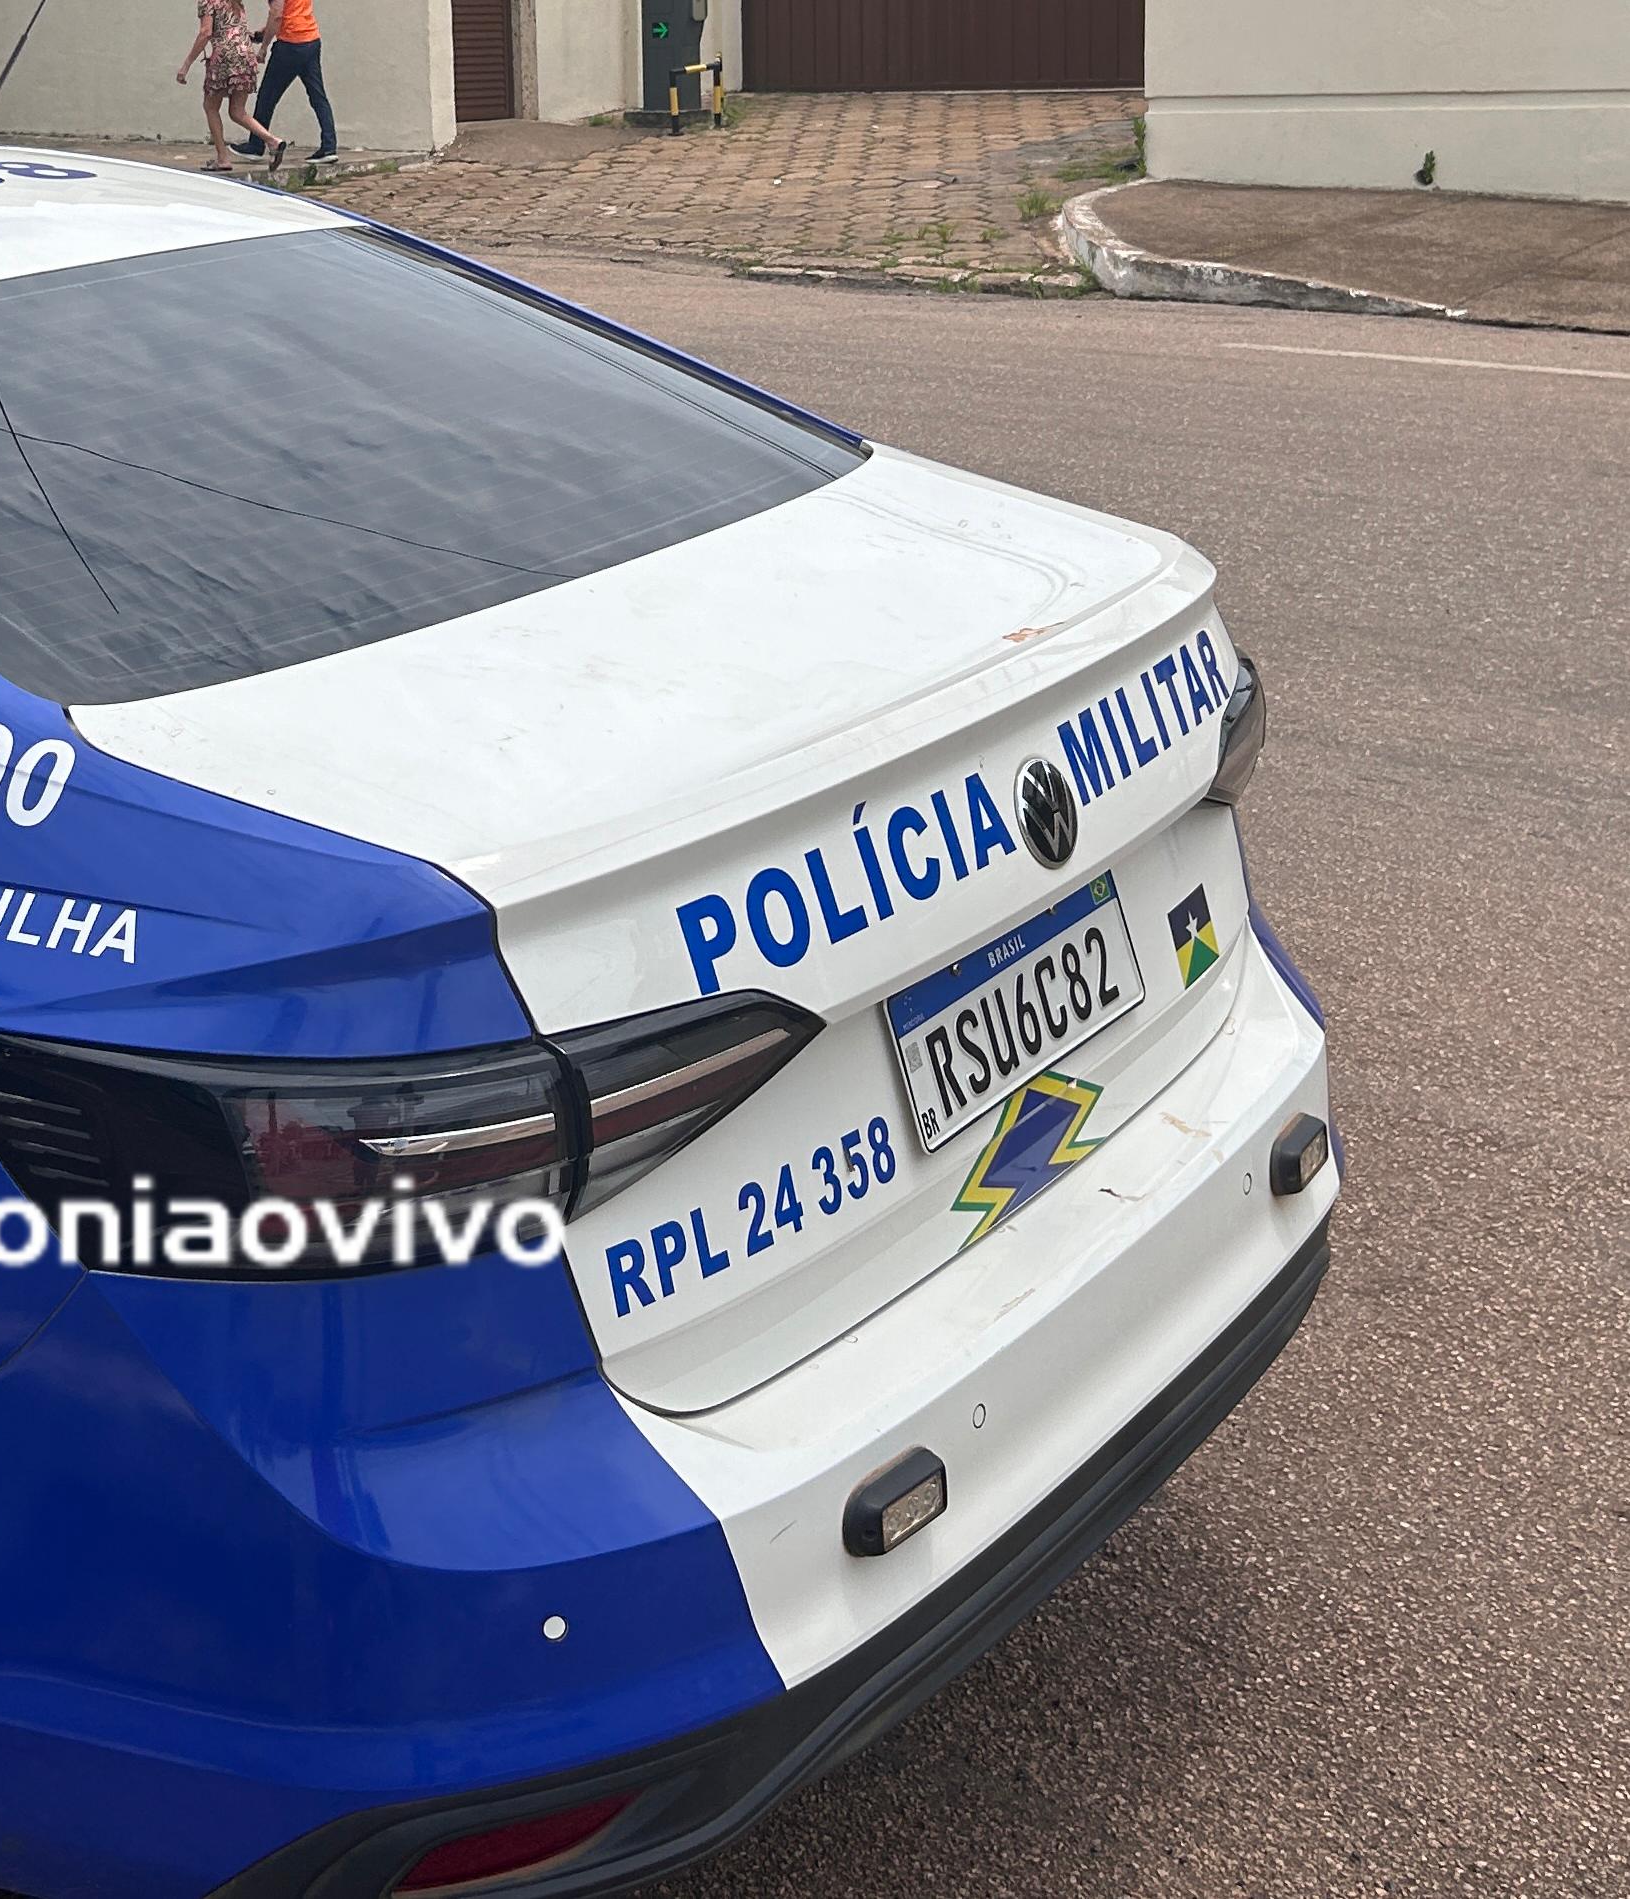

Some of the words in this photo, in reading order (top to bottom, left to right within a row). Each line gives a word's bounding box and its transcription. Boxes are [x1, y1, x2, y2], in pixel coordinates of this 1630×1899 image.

[1056, 629, 1230, 806] MILITAR
[676, 772, 1017, 995] POLÍCIA
[987, 933, 1026, 969] BRASIL
[925, 927, 1120, 1119] RSU6C82
[921, 1107, 941, 1140] BR
[605, 1207, 731, 1318] RPL
[738, 1163, 804, 1257] 24
[812, 1116, 896, 1225] 358
